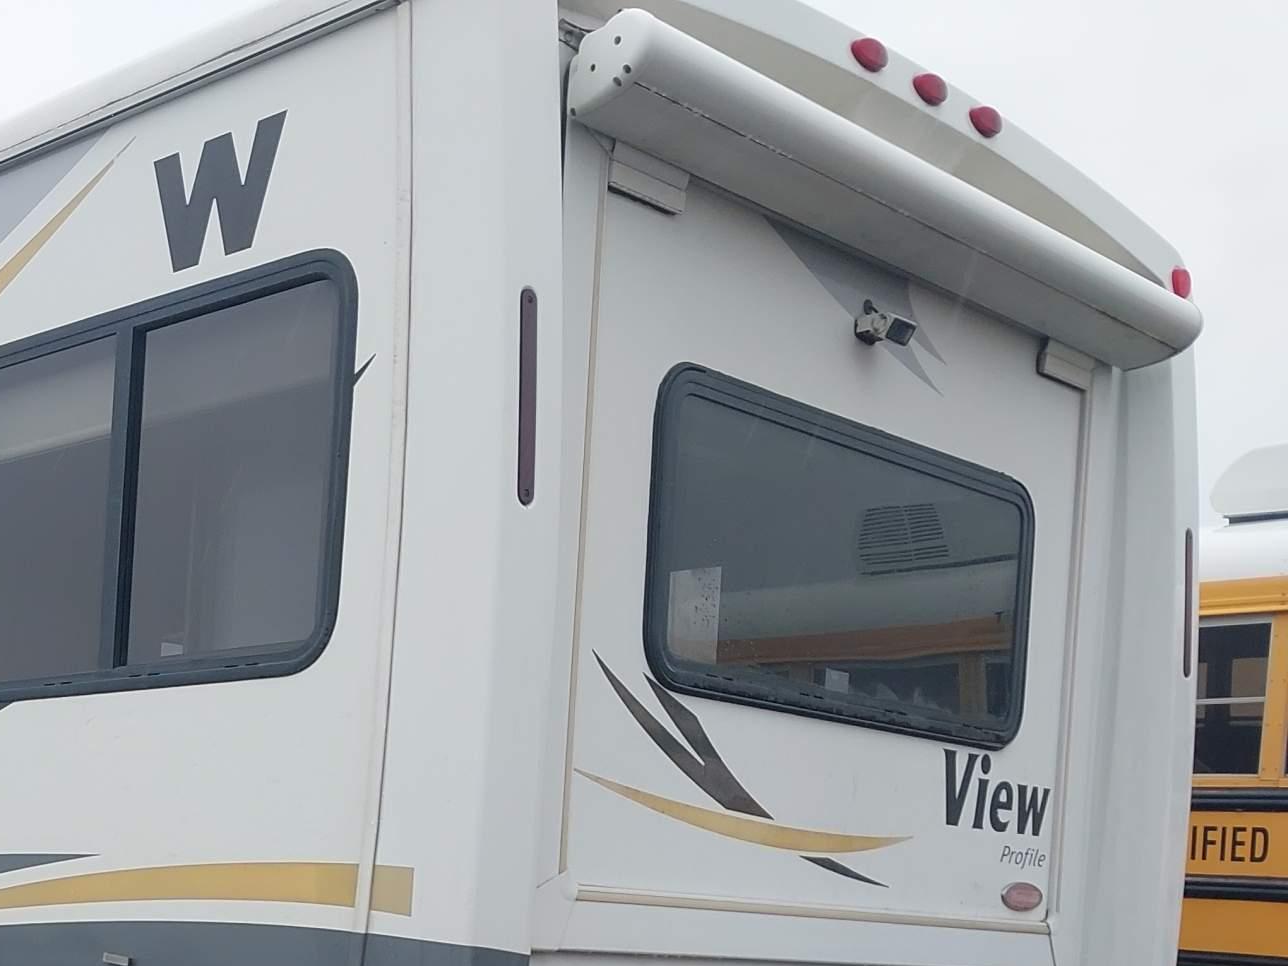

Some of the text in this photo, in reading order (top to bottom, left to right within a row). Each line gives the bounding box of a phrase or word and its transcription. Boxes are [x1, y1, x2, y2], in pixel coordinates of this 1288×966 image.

[153, 109, 289, 273] W
[943, 748, 1051, 837] View
[999, 845, 1047, 870] Profile
[1190, 825, 1270, 863] IFIED
